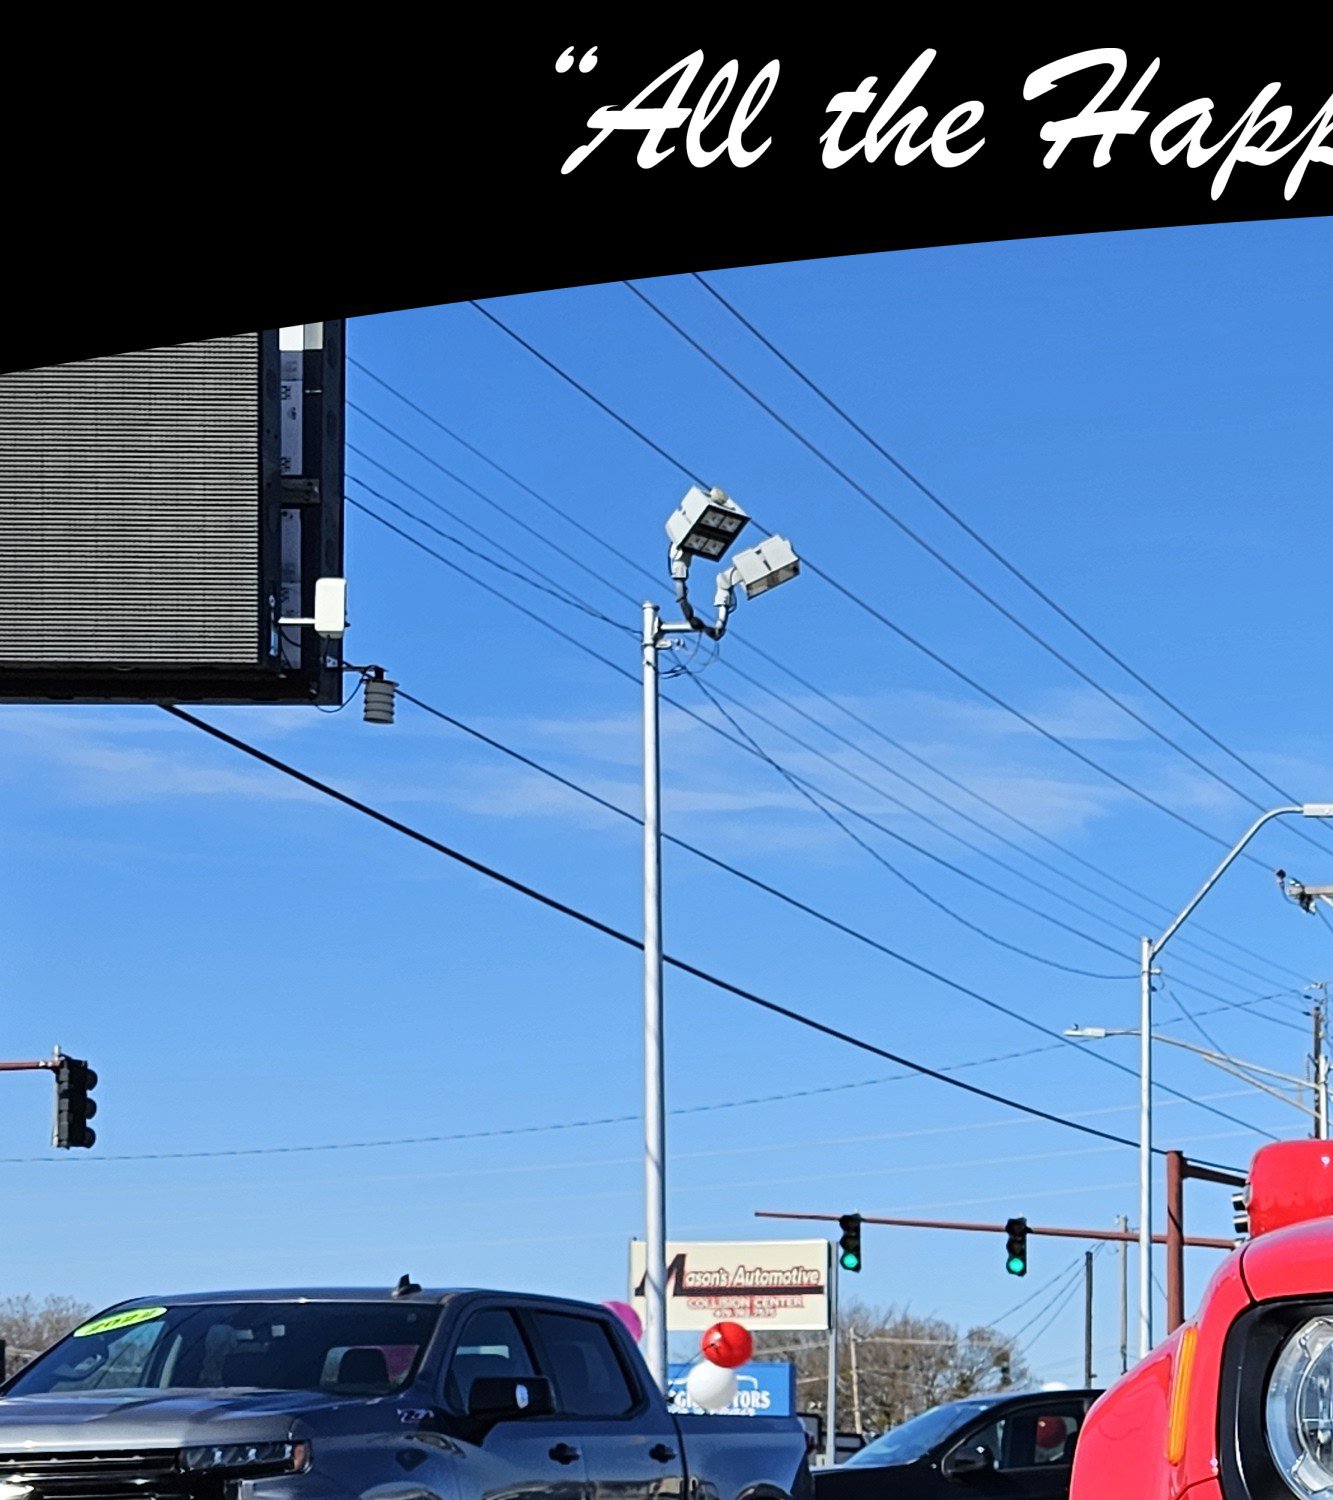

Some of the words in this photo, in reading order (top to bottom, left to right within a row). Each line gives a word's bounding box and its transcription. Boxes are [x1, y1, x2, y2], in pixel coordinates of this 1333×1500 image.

[731, 1264, 821, 1287] Automotive
[686, 1295, 750, 1310] COLLISION
[753, 1295, 805, 1309] CENTER
